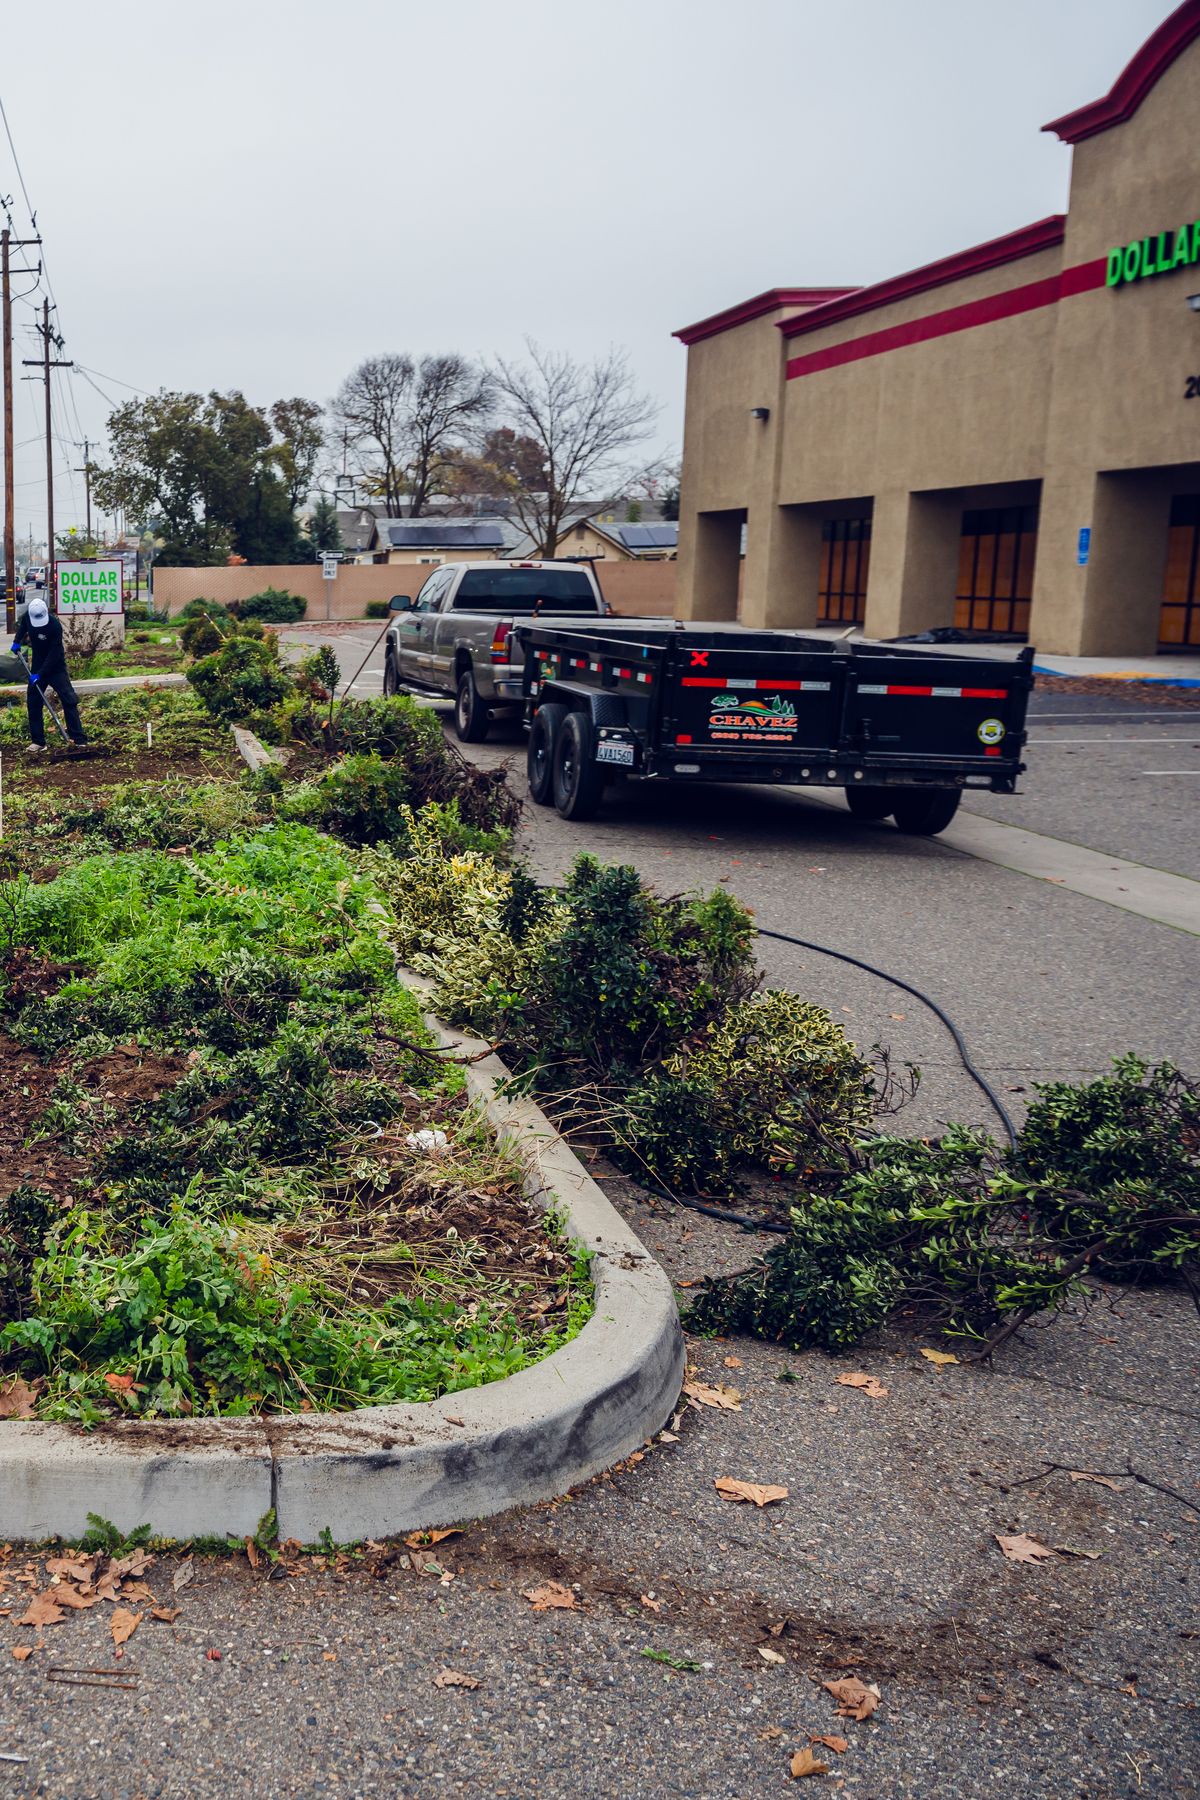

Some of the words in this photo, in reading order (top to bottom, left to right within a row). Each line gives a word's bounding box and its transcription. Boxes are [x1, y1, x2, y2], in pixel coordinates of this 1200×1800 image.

[1183, 375, 1200, 400] 2
[61, 572, 118, 586] DOLLAR
[62, 589, 118, 604] SAVERS
[709, 714, 798, 727] CHAVEZ
